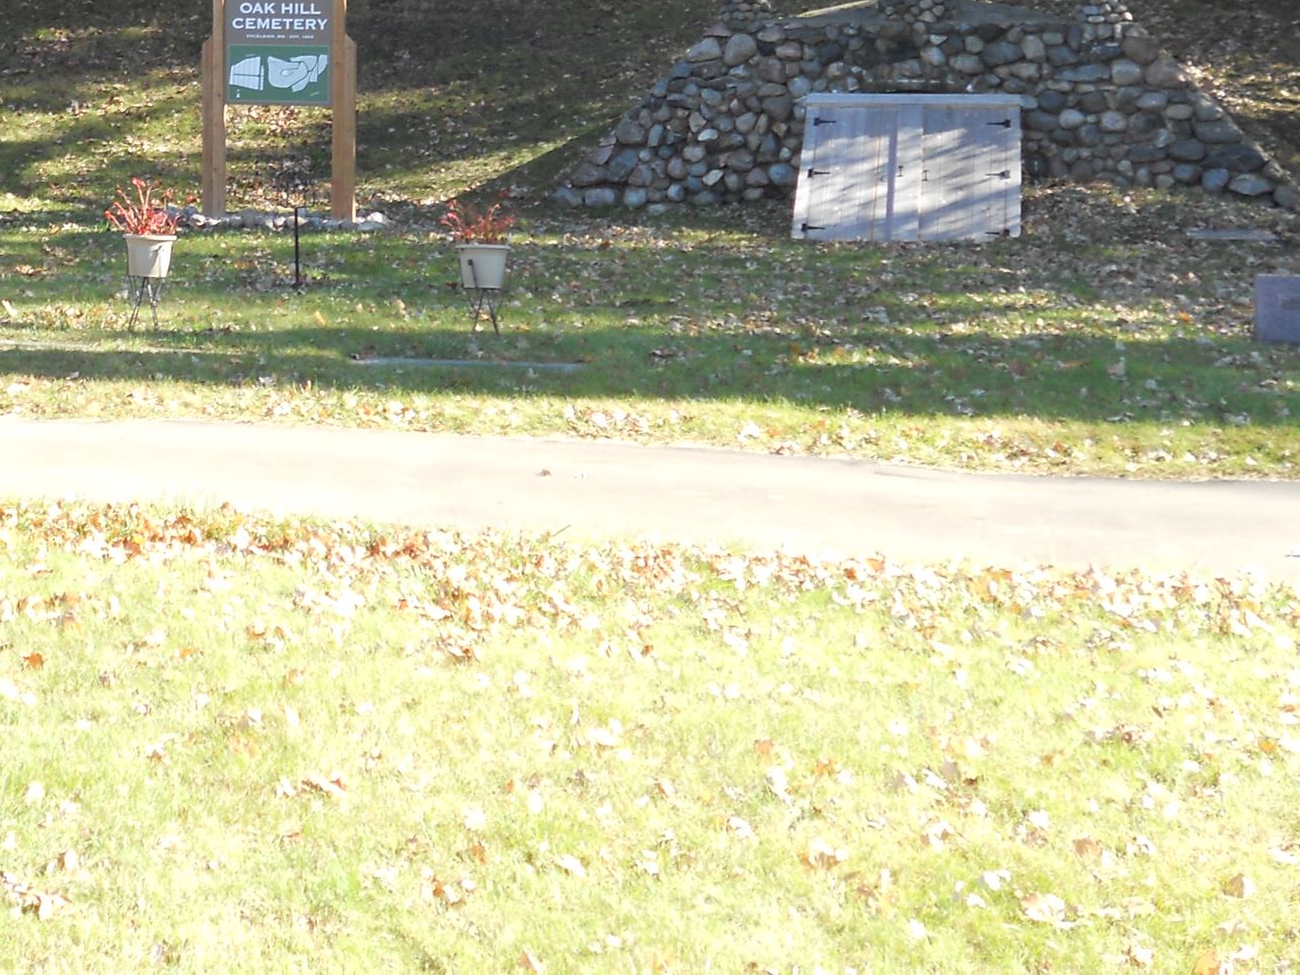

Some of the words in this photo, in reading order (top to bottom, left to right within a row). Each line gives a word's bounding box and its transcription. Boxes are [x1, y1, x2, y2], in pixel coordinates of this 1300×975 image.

[239, 2, 276, 14] OAK
[281, 3, 321, 15] HILL
[232, 18, 328, 30] CEMETERY
